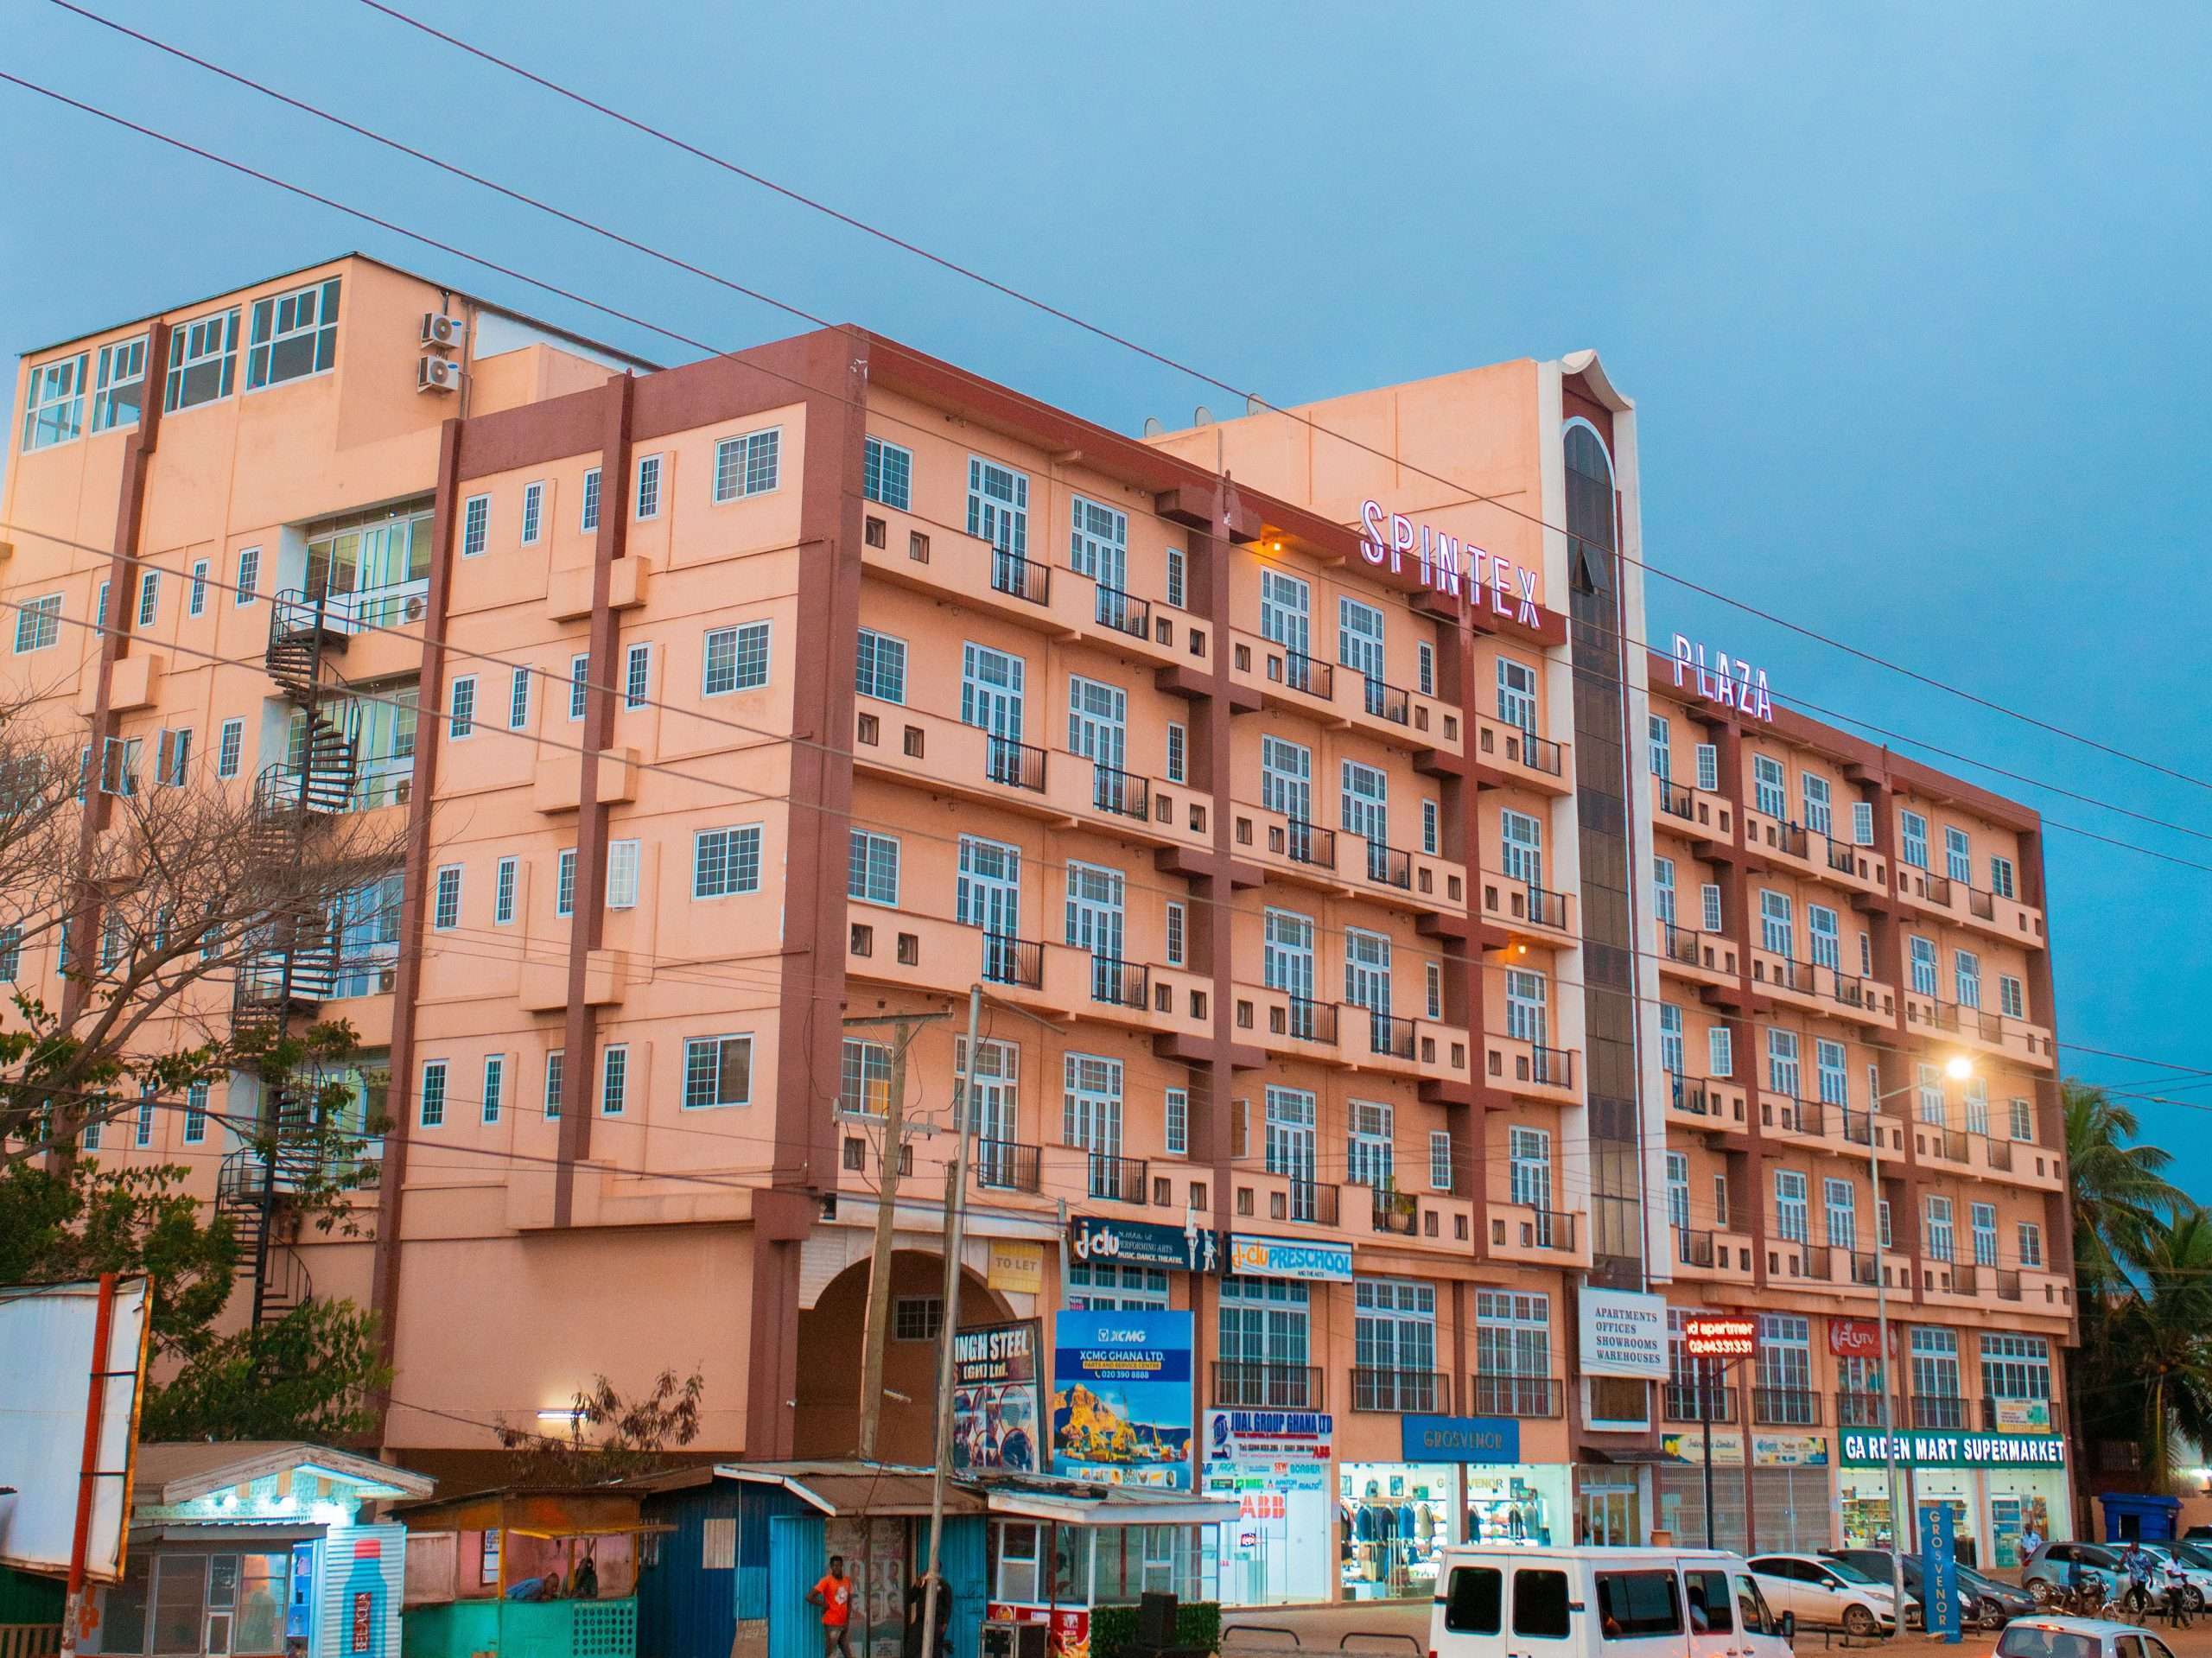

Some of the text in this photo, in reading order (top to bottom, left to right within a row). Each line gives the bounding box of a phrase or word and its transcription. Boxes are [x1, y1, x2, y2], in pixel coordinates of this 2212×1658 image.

[1360, 499, 1541, 629] SPINTEX
[1673, 632, 1773, 723] PLAZA
[995, 1257, 1037, 1272] TO LET
[1268, 1247, 1351, 1274] PRESCHOOL
[1595, 1307, 1657, 1323] APARTMENTS
[1596, 1321, 1636, 1334] OFFICES
[1110, 1331, 1146, 1343] XCMG
[1596, 1336, 1657, 1350] SHOWROOMS
[955, 1330, 1029, 1363] INGH STEEL
[1080, 1350, 1166, 1362] XCMG GHANA LTD.
[1597, 1350, 1661, 1363] WAREHOUSES
[988, 1363, 1008, 1378] Ltd.
[1230, 1412, 1332, 1434] JUAL GROUP GHANA LTD
[1424, 1431, 1502, 1450] GROSVENOR
[1313, 1445, 1330, 1458] ABB
[1916, 1438, 1957, 1460] MART
[1963, 1439, 2063, 1462] SUPERMARKET
[1239, 1496, 1286, 1519] ABB
[1929, 1511, 1948, 1625] GROSVENOR
